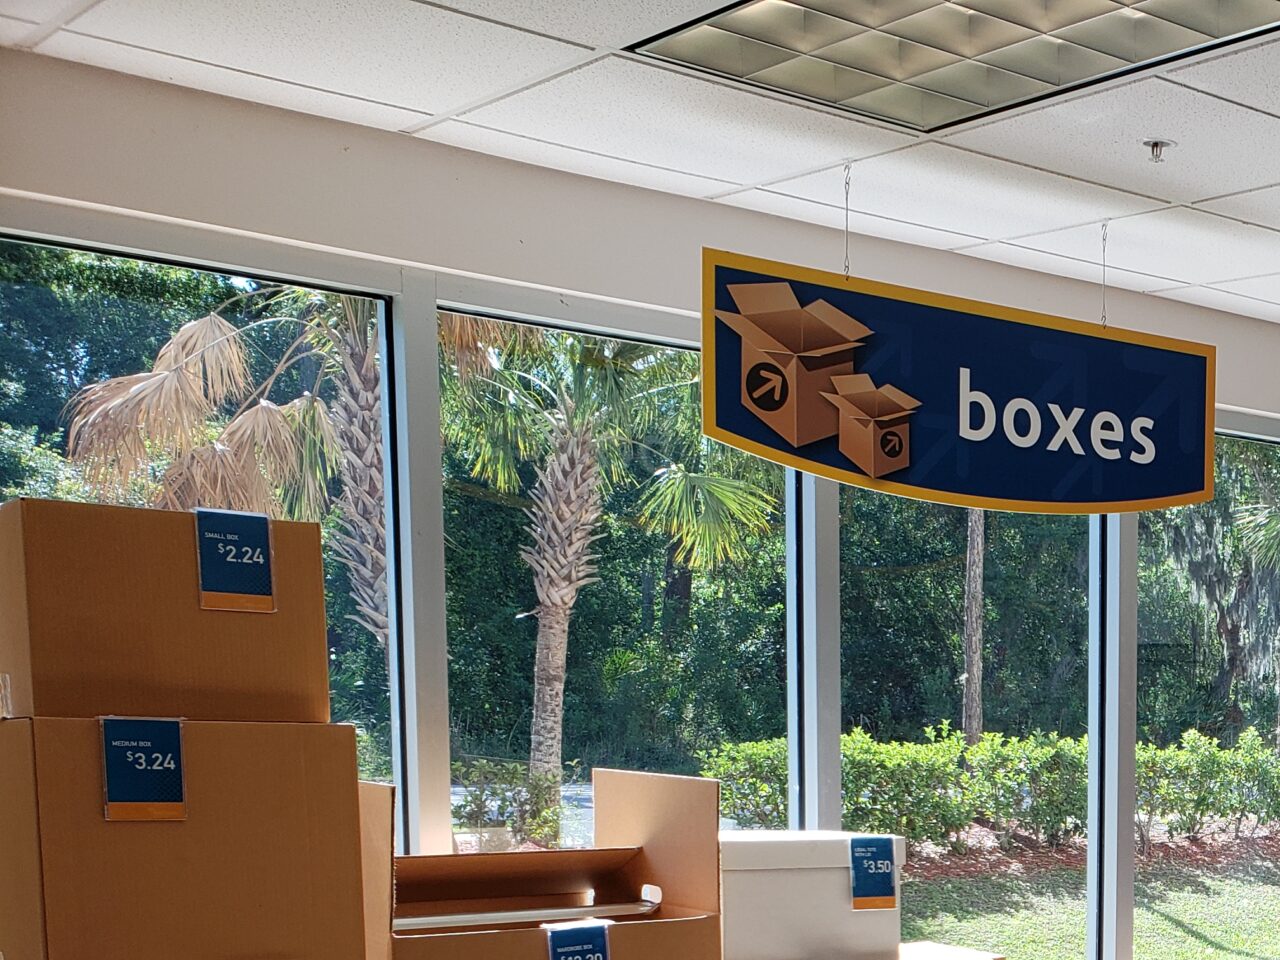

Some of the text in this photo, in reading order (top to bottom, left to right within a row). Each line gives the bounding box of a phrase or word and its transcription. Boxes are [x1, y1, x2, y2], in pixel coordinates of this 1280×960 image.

[959, 367, 1156, 464] boxes
[204, 532, 225, 540] SMALL
[217, 542, 264, 564] $2.24
[126, 750, 176, 770] $3.24
[863, 860, 891, 873] $3.50
